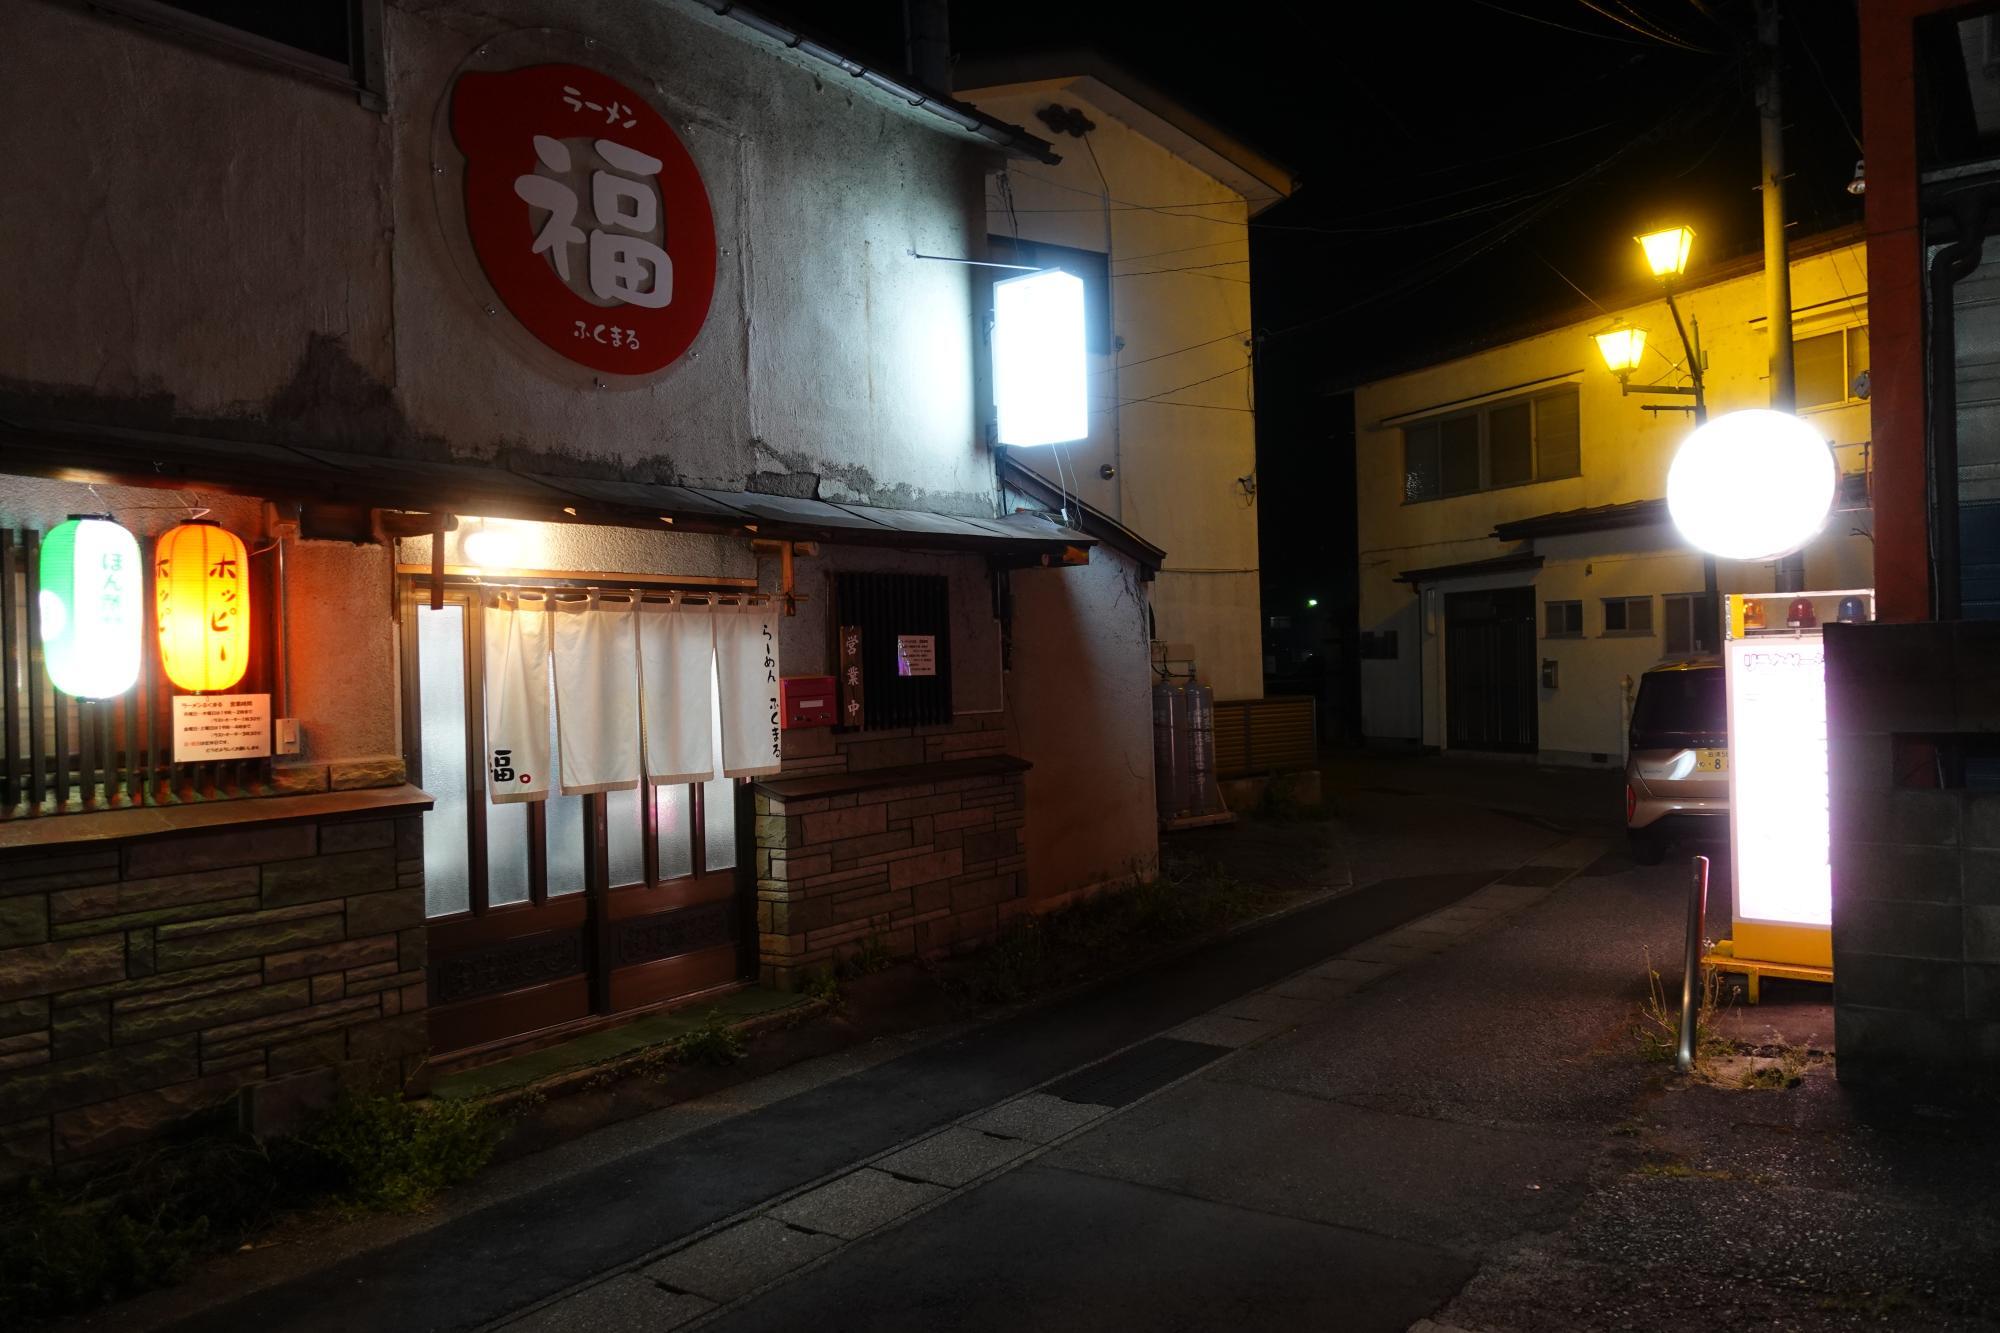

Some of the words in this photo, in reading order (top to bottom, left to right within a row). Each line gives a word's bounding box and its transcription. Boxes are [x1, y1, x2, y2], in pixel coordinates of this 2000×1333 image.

[563, 85, 637, 129] ラーメン
[513, 135, 674, 309] 福
[573, 320, 640, 350] ふくまる
[209, 552, 237, 662] ホッピー
[762, 625, 776, 684] らーめん
[769, 698, 781, 758] ふくまる
[846, 634, 860, 717] 営業中
